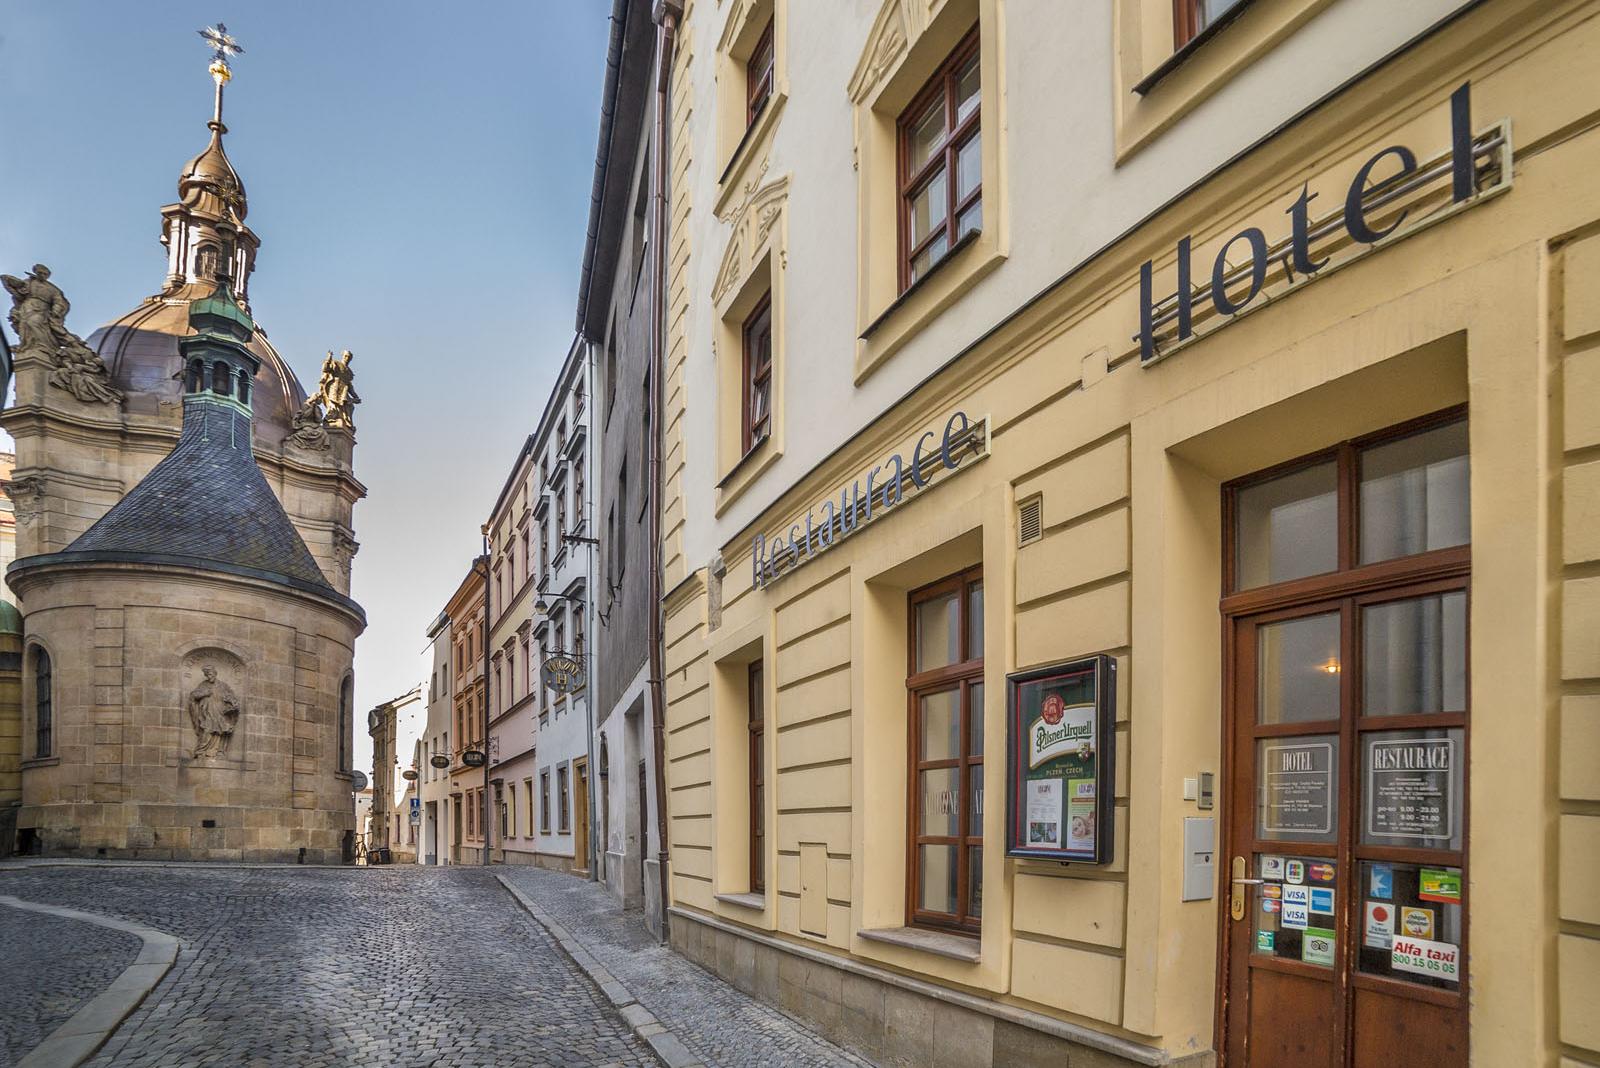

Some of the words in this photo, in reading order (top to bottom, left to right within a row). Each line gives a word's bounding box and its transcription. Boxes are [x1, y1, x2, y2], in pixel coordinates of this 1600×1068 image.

[1139, 80, 1473, 362] Hotel
[751, 411, 968, 591] Restaurace
[1036, 726, 1065, 753] Pilsner
[1063, 720, 1092, 742] Urquell
[1282, 751, 1313, 771] HOTEL
[1375, 747, 1448, 769] RESTAURACE
[1287, 890, 1306, 900] VISA
[1286, 910, 1306, 920] VISA
[1394, 941, 1422, 957] Alfa
[1426, 948, 1456, 963] taxi
[1412, 957, 1425, 968] 15
[1426, 960, 1440, 971] 05
[1442, 963, 1456, 974] 05
